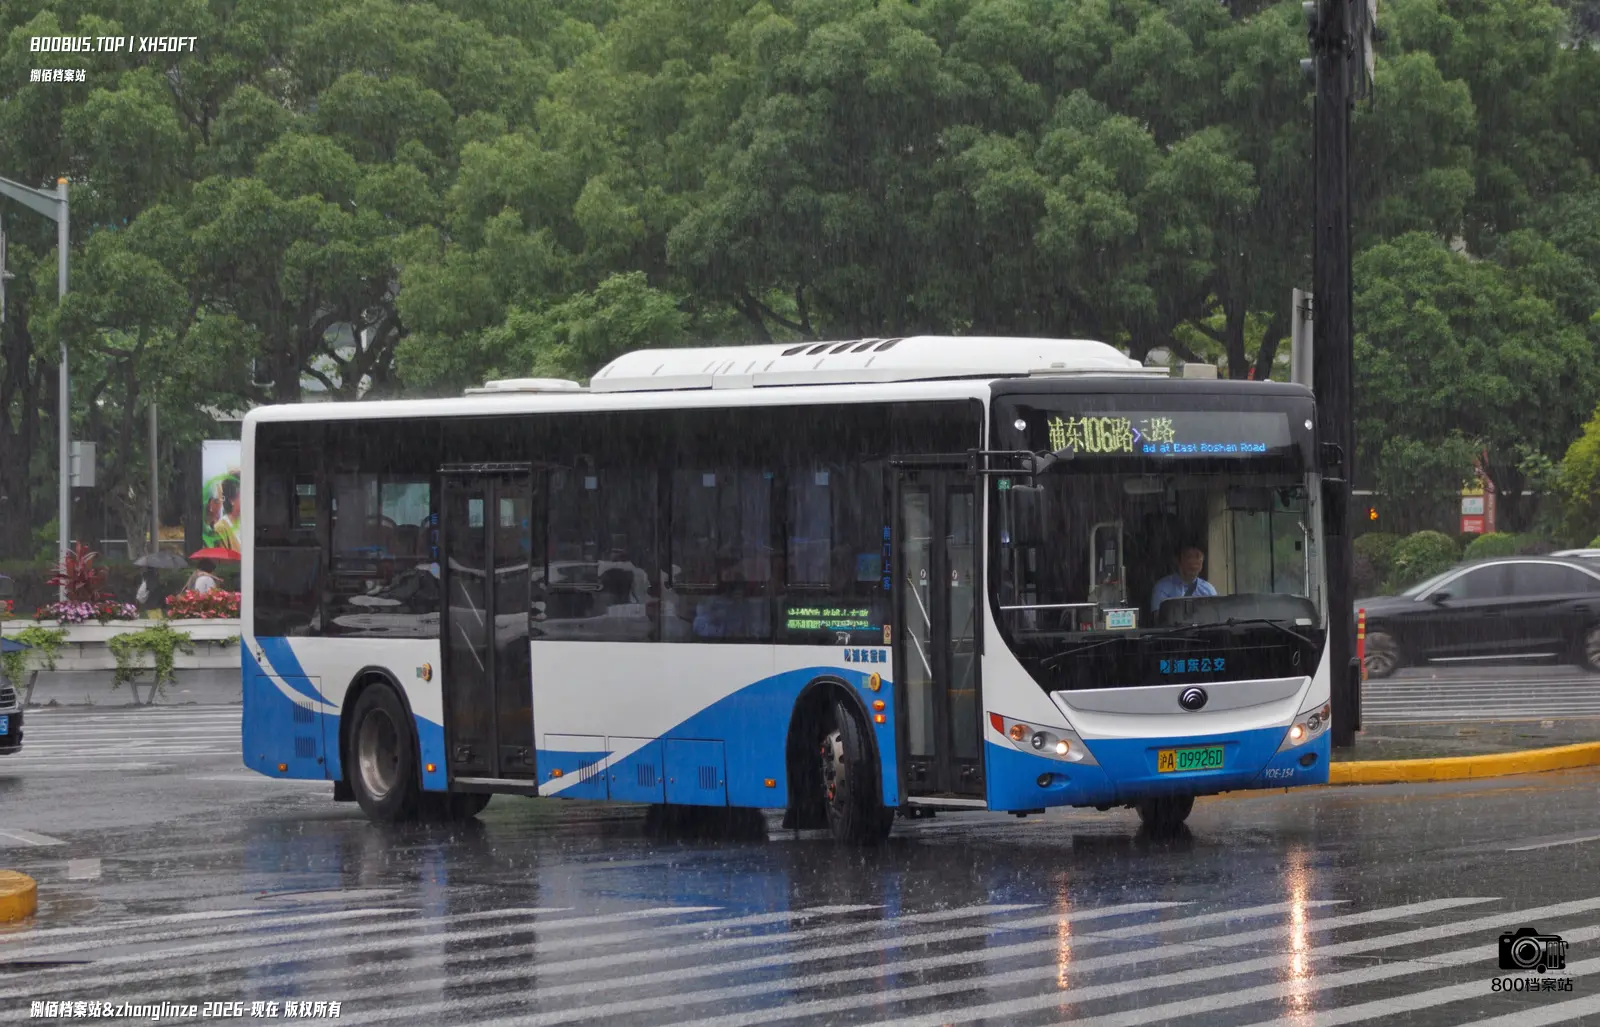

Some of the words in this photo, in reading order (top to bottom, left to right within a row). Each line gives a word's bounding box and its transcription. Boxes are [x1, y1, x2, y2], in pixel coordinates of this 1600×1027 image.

[1160, 443, 1170, 453] at
[1173, 443, 1198, 453] East
[1200, 443, 1238, 453] Boshan
[1240, 442, 1266, 452] Road
[1173, 657, 1225, 673] 浦东公交
[1179, 749, 1223, 768] 09926D
